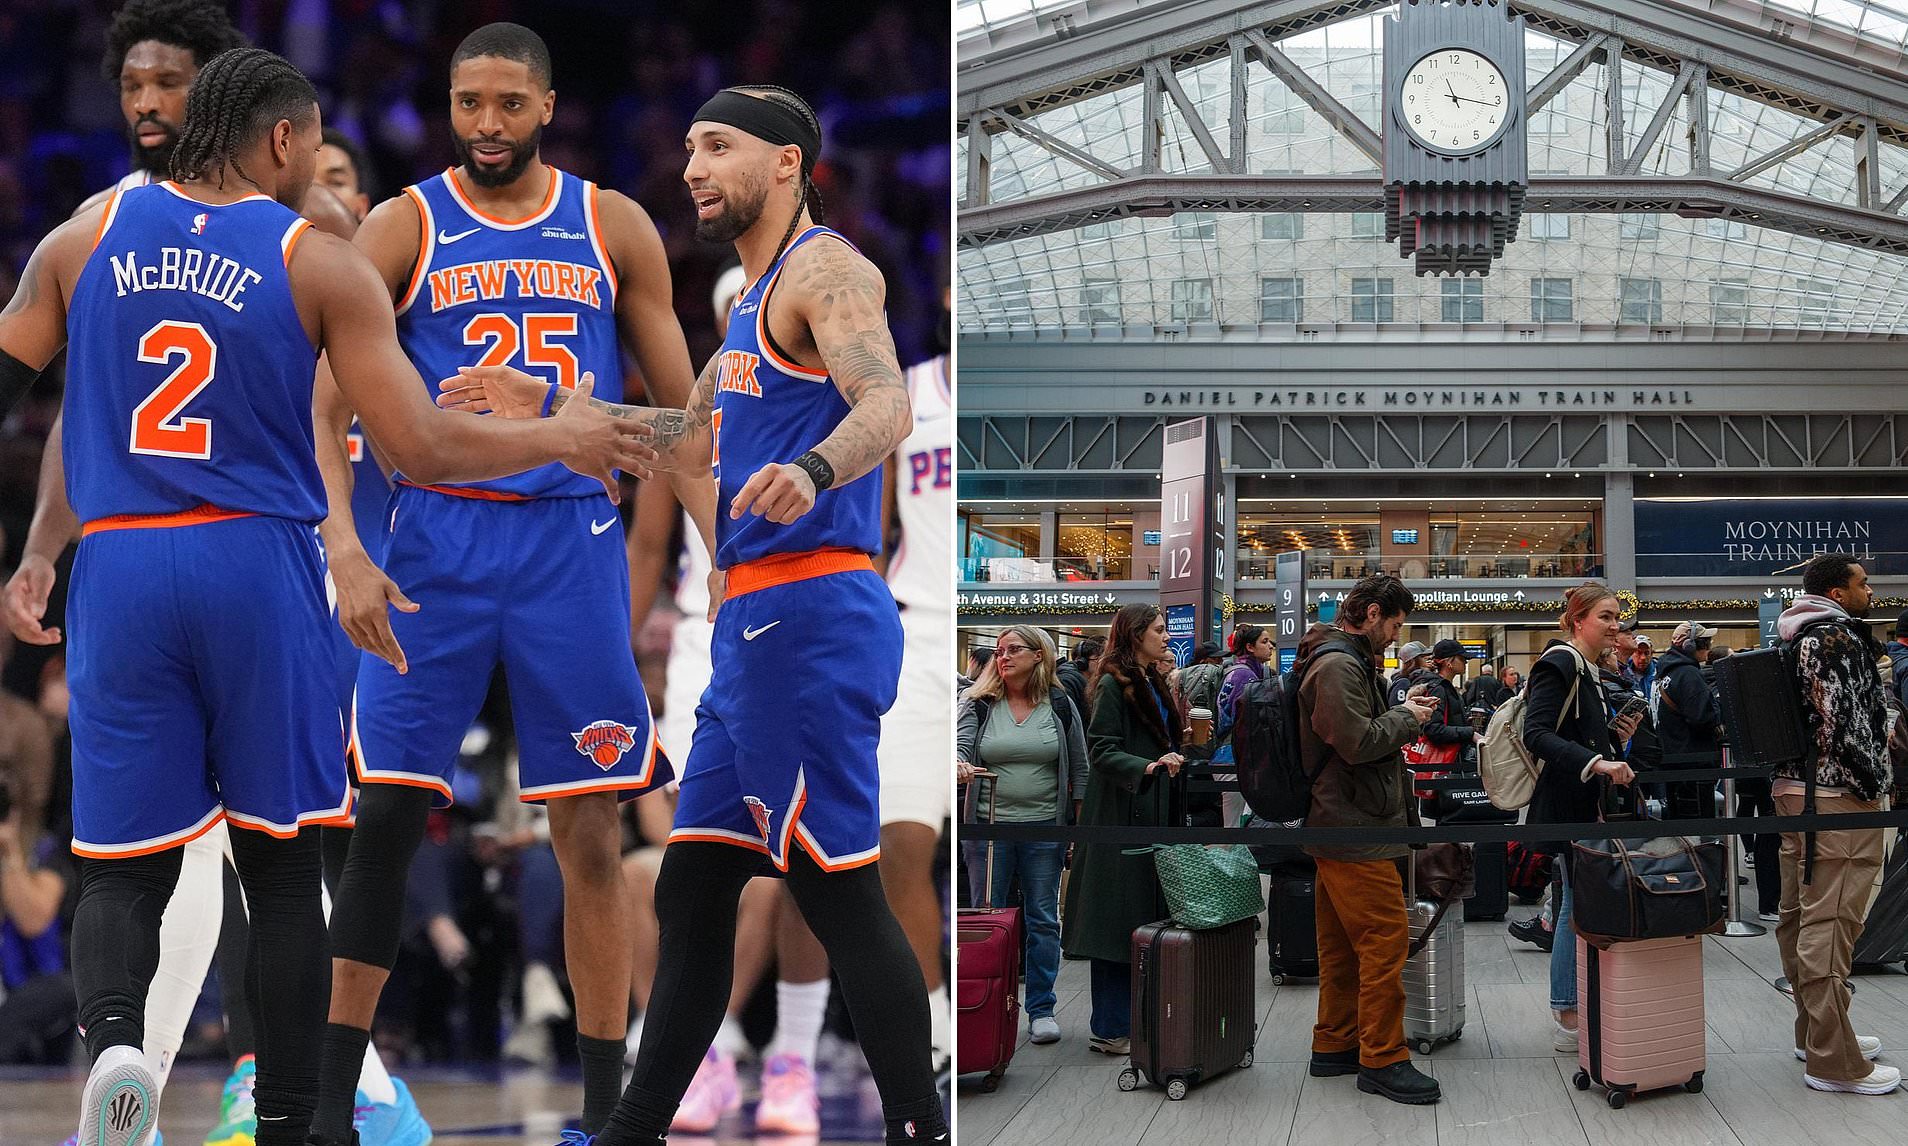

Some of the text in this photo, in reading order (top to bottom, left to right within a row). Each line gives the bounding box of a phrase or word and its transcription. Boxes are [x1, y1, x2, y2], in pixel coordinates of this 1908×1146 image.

[1429, 59, 1438, 69] 11
[1449, 54, 1460, 65] 12
[1474, 60, 1479, 69] 1
[1412, 74, 1424, 84] 10
[1488, 74, 1495, 85] 2
[1408, 94, 1415, 104] 9
[1494, 95, 1501, 105] 3
[1414, 114, 1422, 124] 8
[1488, 114, 1495, 124] 4
[1430, 129, 1437, 140] 7
[1452, 135, 1459, 146] 6
[1473, 129, 1480, 140] 5
[541, 230, 586, 240] abu dhabi
[109, 247, 263, 313] McBRIDE
[428, 259, 602, 314] NEW YORK
[463, 312, 579, 392] 25
[718, 349, 763, 399] ORK
[129, 319, 217, 460] 2
[1144, 391, 1695, 406] DANIEL PATRICK MOYNIHAN TRAIN HALL
[1173, 491, 1190, 523] 11
[1217, 492, 1224, 525] 11
[1725, 520, 1871, 540] MOYNIHAN
[1723, 543, 1802, 561] TRAIN
[1169, 547, 1192, 579] 12
[1215, 547, 1224, 580] 12
[971, 593, 1017, 605] Avenue
[1019, 593, 1029, 605] &
[1032, 593, 1058, 605] 31st
[1061, 593, 1100, 605] Street
[1283, 589, 1292, 606] 9
[1464, 591, 1509, 604] Lounge
[1780, 587, 1806, 599] 31st
[1281, 617, 1295, 636] 10
[1767, 620, 1775, 633] 7
[578, 725, 634, 750] KNICKS
[1452, 791, 1471, 799] RIVE
